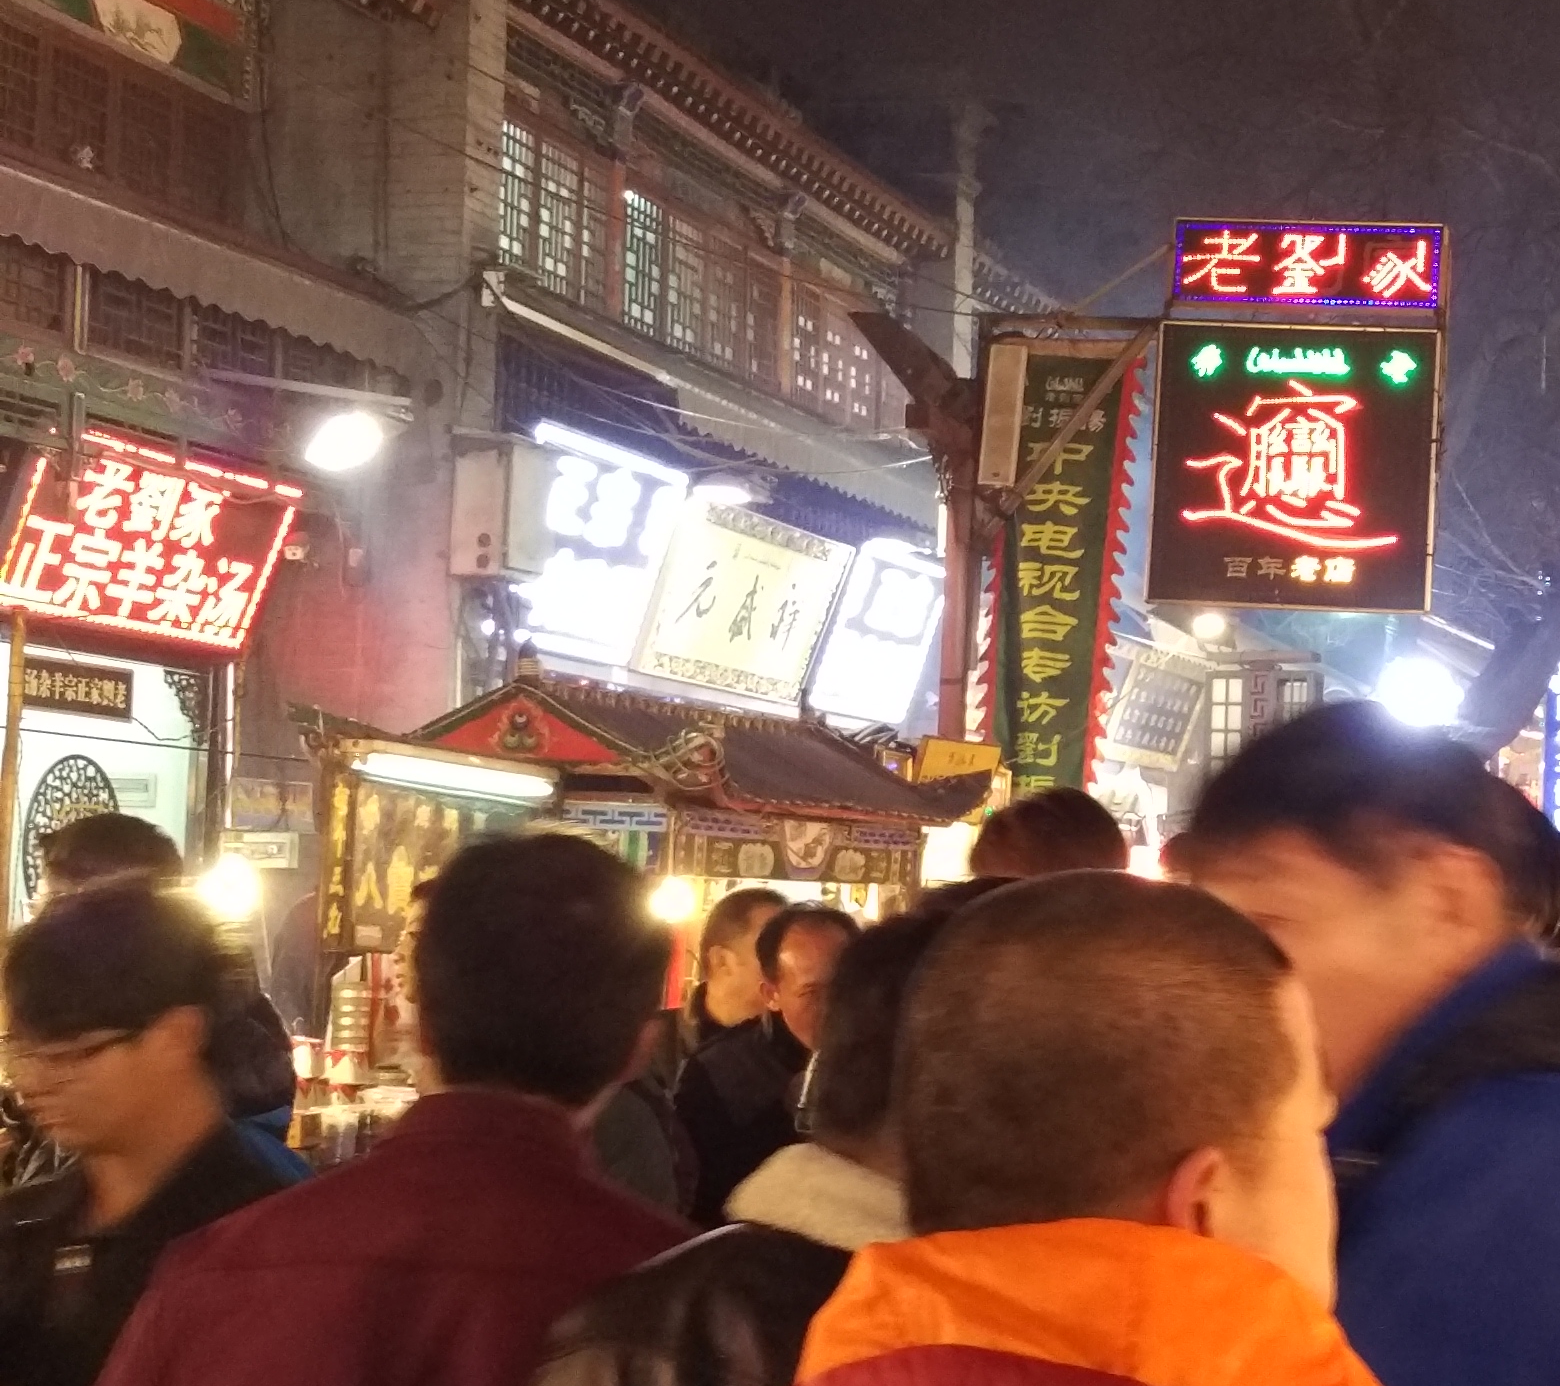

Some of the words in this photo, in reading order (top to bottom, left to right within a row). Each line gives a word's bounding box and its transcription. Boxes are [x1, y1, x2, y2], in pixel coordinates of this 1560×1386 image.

[2, 513, 254, 629] 正宗羊杂汤
[1223, 555, 1357, 585] 百年老店
